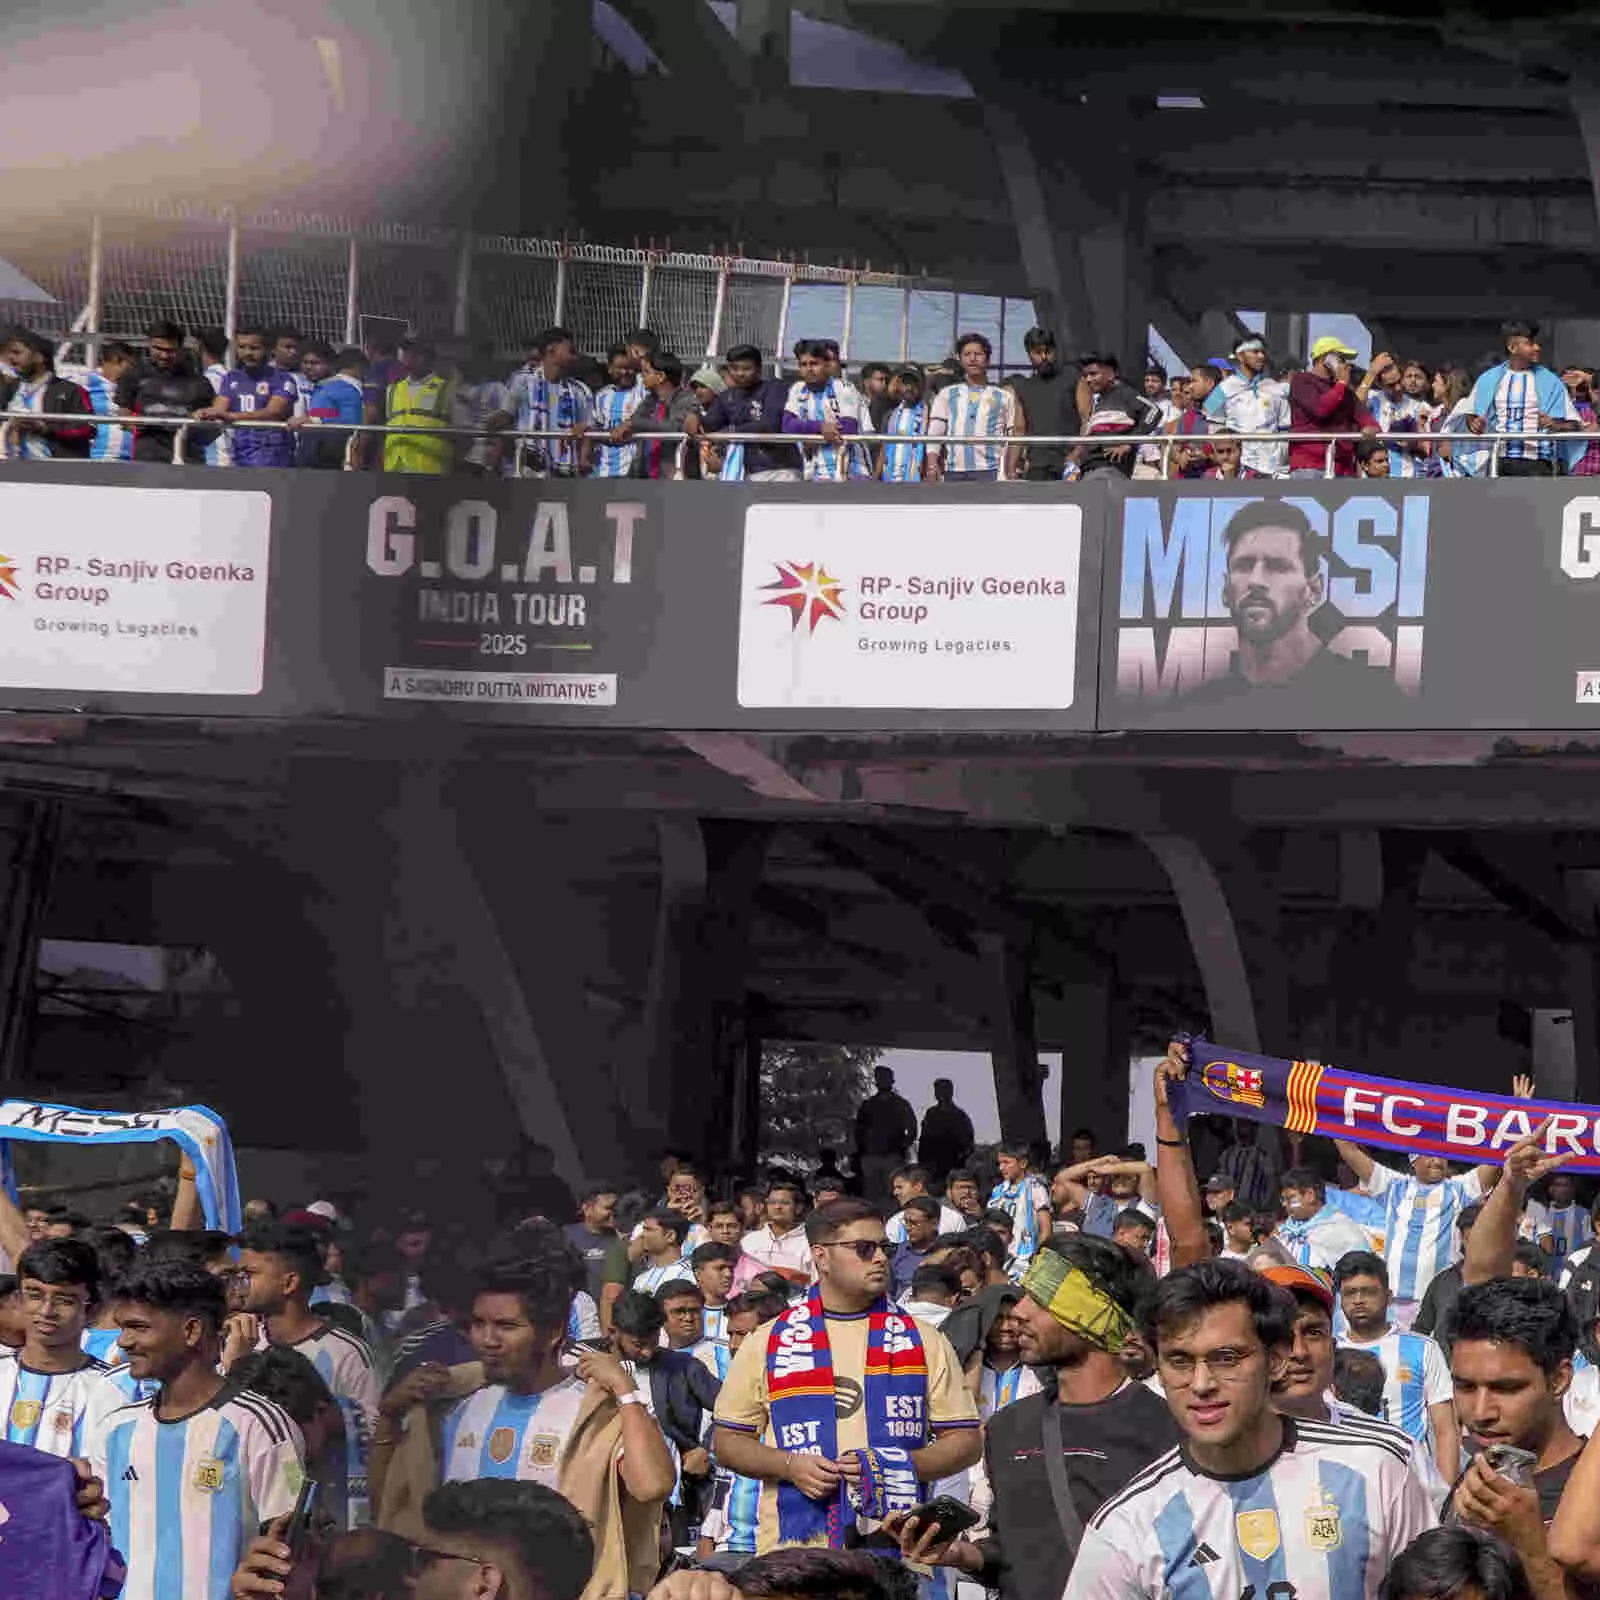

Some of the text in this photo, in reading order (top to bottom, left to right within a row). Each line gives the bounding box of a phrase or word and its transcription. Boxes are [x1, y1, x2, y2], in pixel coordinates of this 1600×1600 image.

[166, 561, 256, 582] Goenka
[35, 582, 110, 606] Group
[982, 577, 1066, 597] Goenka
[418, 589, 587, 626] INDIA TOUR
[859, 602, 928, 624] Group
[34, 618, 199, 639] Growing Legacies
[479, 632, 527, 655] 2025
[858, 637, 1012, 655] Growing Legacies
[477, 680, 522, 698] DUTTA
[522, 682, 598, 700] INITIATIVE
[1583, 681, 1594, 697] A
[1342, 1085, 1427, 1137] FC
[885, 1395, 924, 1419] EST
[781, 1420, 821, 1447] EST
[885, 1420, 922, 1439] 1899
